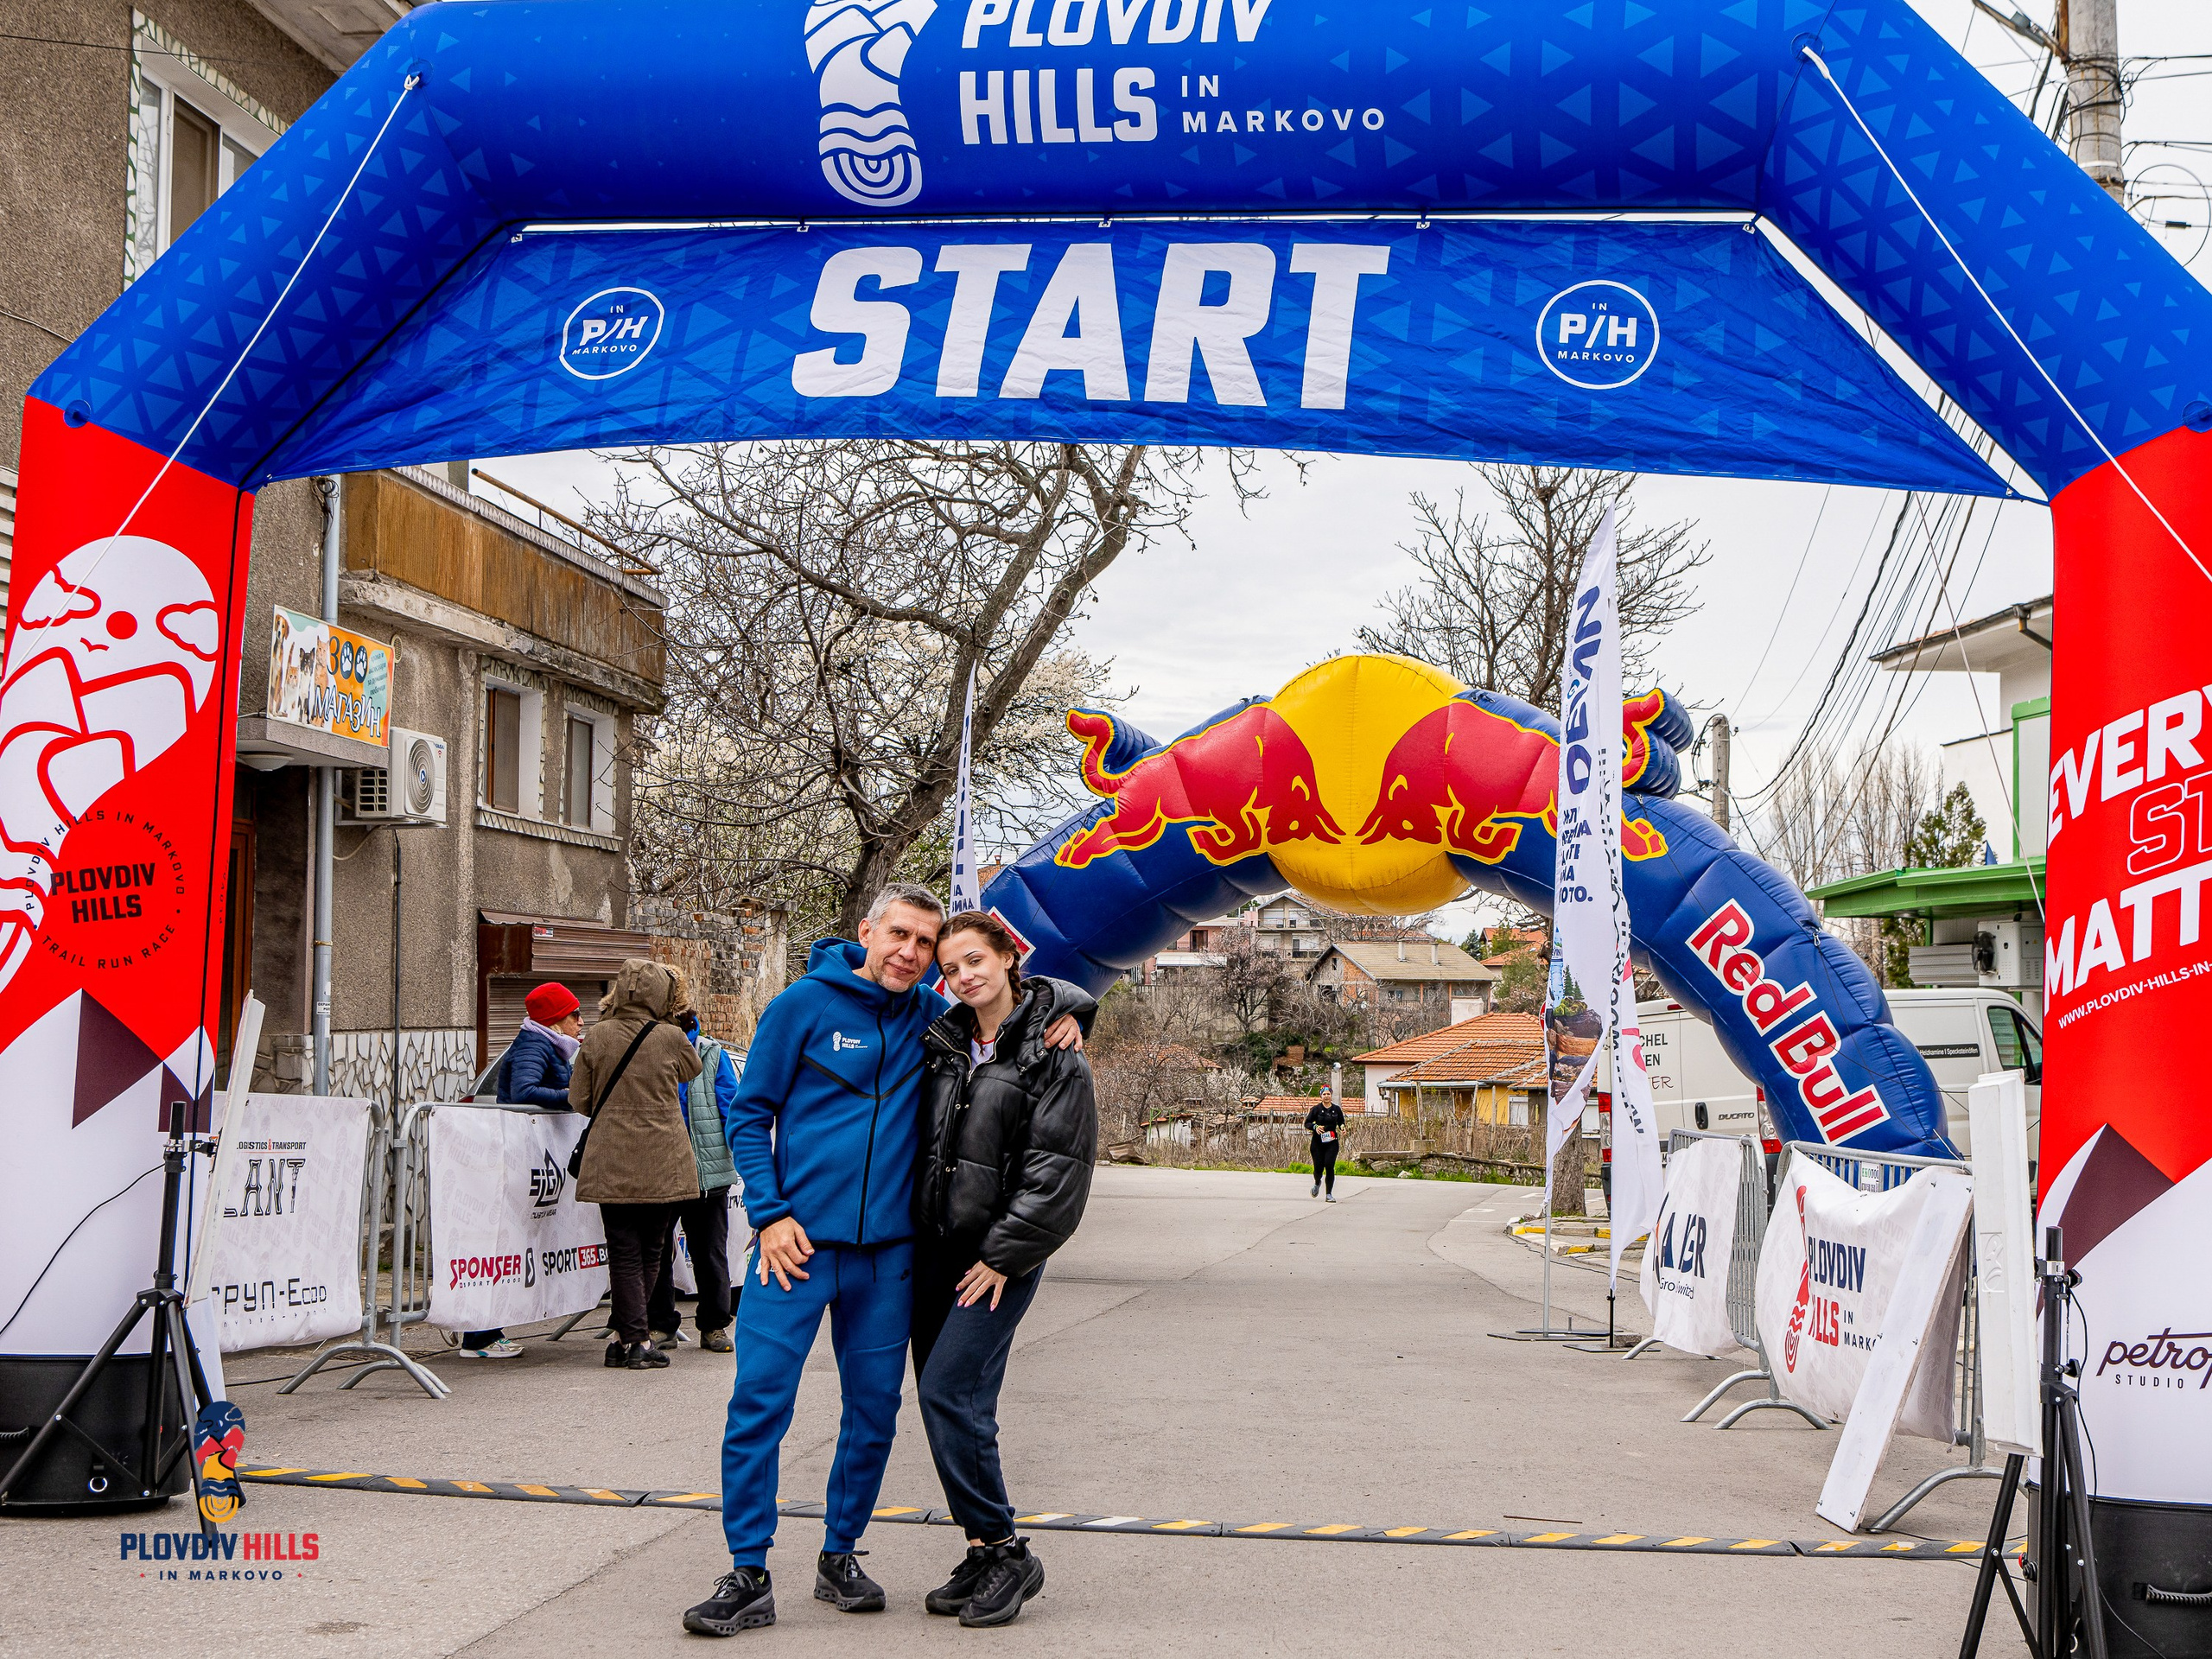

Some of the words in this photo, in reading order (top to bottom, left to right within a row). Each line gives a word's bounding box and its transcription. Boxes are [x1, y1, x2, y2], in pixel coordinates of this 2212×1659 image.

[962, 0, 1275, 48] PLOVDIV
[1181, 75, 1219, 98] IN
[960, 67, 1157, 145] HILLS
[1182, 107, 1385, 134] MARKOVO
[610, 305, 624, 314] IN
[1592, 302, 1607, 311] IN
[579, 316, 648, 346] P/H
[791, 242, 1391, 410] START
[1559, 313, 1637, 349] P/H
[571, 344, 638, 356] MARKOVO
[1557, 350, 1635, 364] MARKOVO
[314, 684, 381, 738] МАГАЗИН
[2048, 686, 2212, 849] EVER
[25, 837, 50, 911] PLOVDIV
[54, 810, 105, 836] HILLS
[117, 811, 135, 824] IN
[143, 822, 185, 894] MARKOVO
[50, 862, 156, 896] PLOVDIV
[71, 894, 143, 924] HILLS
[42, 935, 86, 967] TRAIL
[98, 955, 133, 969] RUN
[141, 924, 175, 959] RACE
[1689, 903, 1813, 1031] Red
[1643, 1053, 1661, 1067] EN
[1648, 1076, 1674, 1090] ER
[1773, 1014, 1885, 1142] Bull
[1718, 1112, 1755, 1121] DUCATO
[236, 1141, 268, 1151] OGISTICS
[272, 1141, 307, 1151] TRANSPORT
[223, 1158, 306, 1218] ANT
[449, 1254, 522, 1291] SPONSER
[1808, 1236, 1866, 1294] PLOVDIV
[1844, 1309, 1853, 1325] IN
[2115, 1374, 2184, 1389] STUDIO
